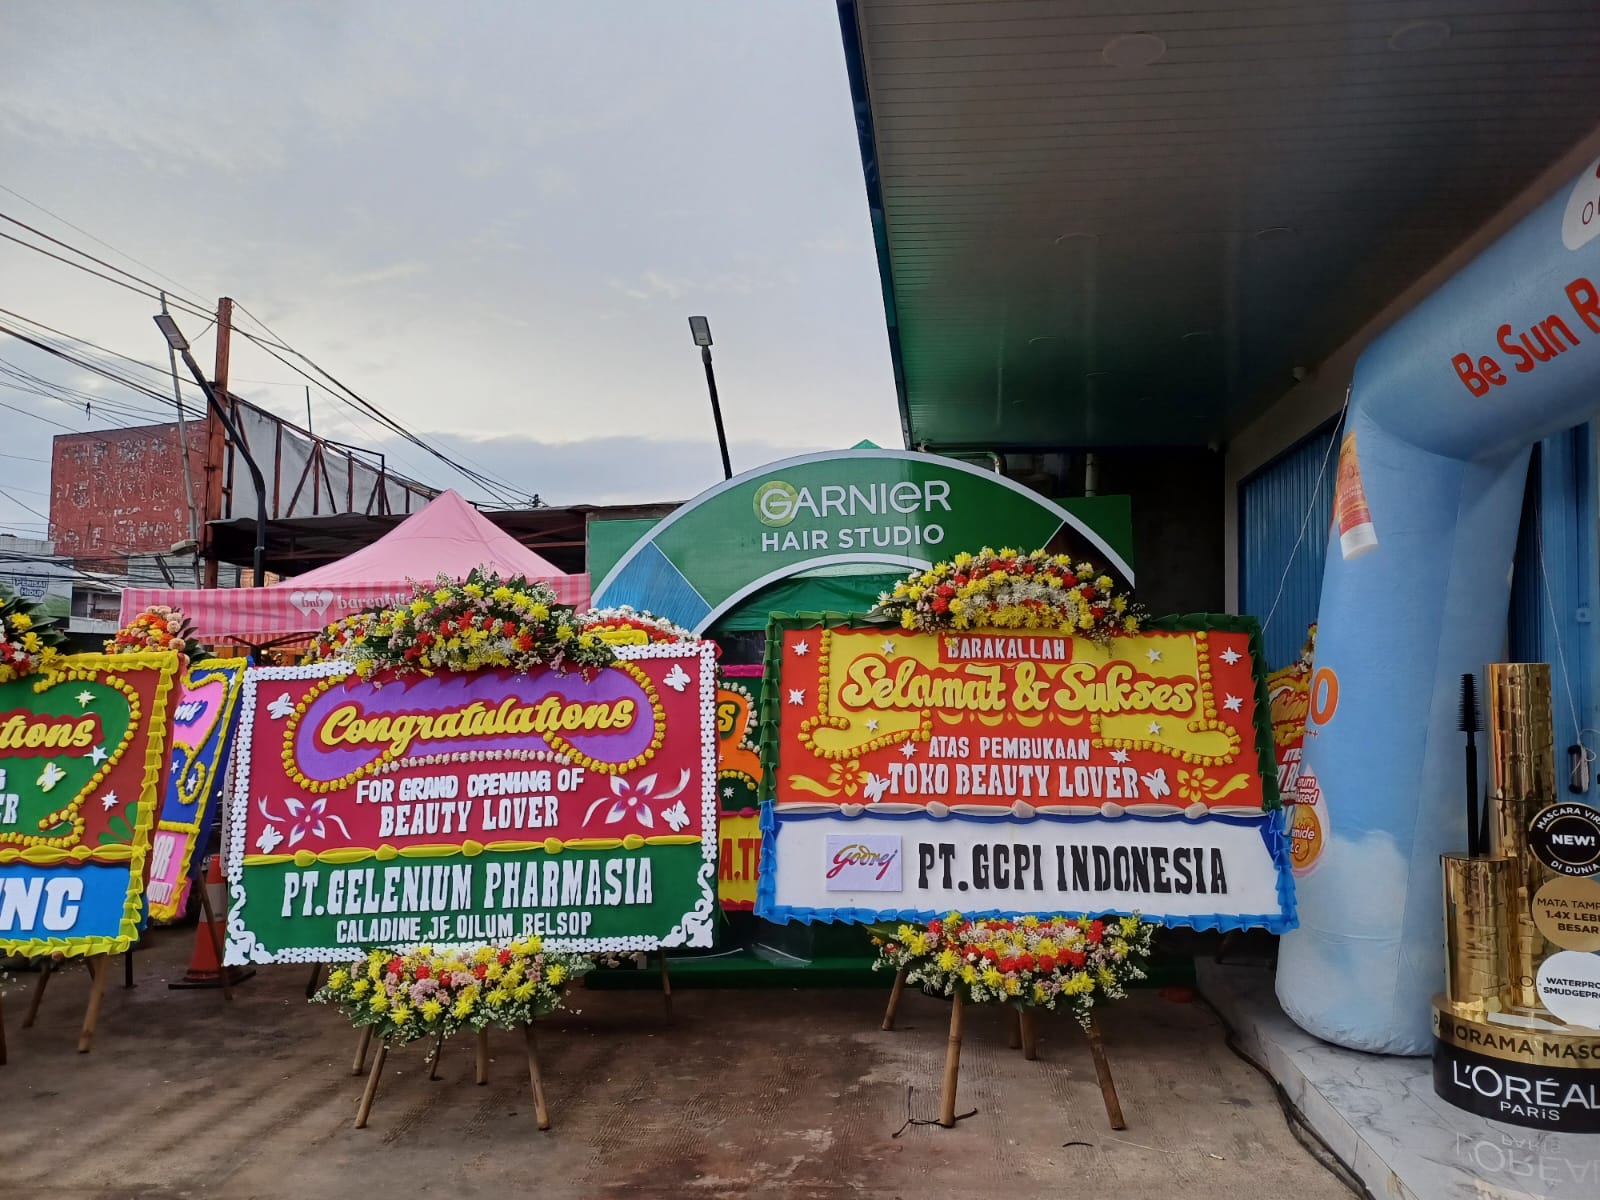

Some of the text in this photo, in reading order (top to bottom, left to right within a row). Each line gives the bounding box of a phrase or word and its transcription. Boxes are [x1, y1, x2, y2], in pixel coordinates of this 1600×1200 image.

[1451, 353, 1507, 398] Be
[1496, 314, 1581, 373] Sun
[761, 524, 945, 552] HAIR STUDIO
[947, 636, 1065, 660] BARAKALLAH
[842, 656, 1196, 713] Selamat & Sukses
[320, 697, 636, 756] Congratulations
[928, 736, 1091, 760] ATAS PEMBUKAAN
[356, 767, 585, 804] FOR GRAND OPENING OF
[887, 762, 1139, 798] TOKO BEAUTY LOVER
[379, 796, 560, 838] BEAUTY LOVER
[1536, 806, 1582, 830] MASCARA
[1552, 834, 1596, 847] NEW!
[918, 843, 1043, 892] PT.GCPI
[1056, 845, 1229, 895] INDONESIA
[1551, 859, 1600, 874] DI DUNIA
[281, 857, 654, 918] PT.GELENIUM PHARMASIA
[0, 877, 84, 931] NC
[1537, 898, 1568, 910] MATA
[1545, 910, 1571, 921] 1.4X
[1558, 922, 1599, 934] BESAR
[1543, 986, 1600, 999] SMUDGEPR
[1452, 1059, 1600, 1111] L'ORÉAL
